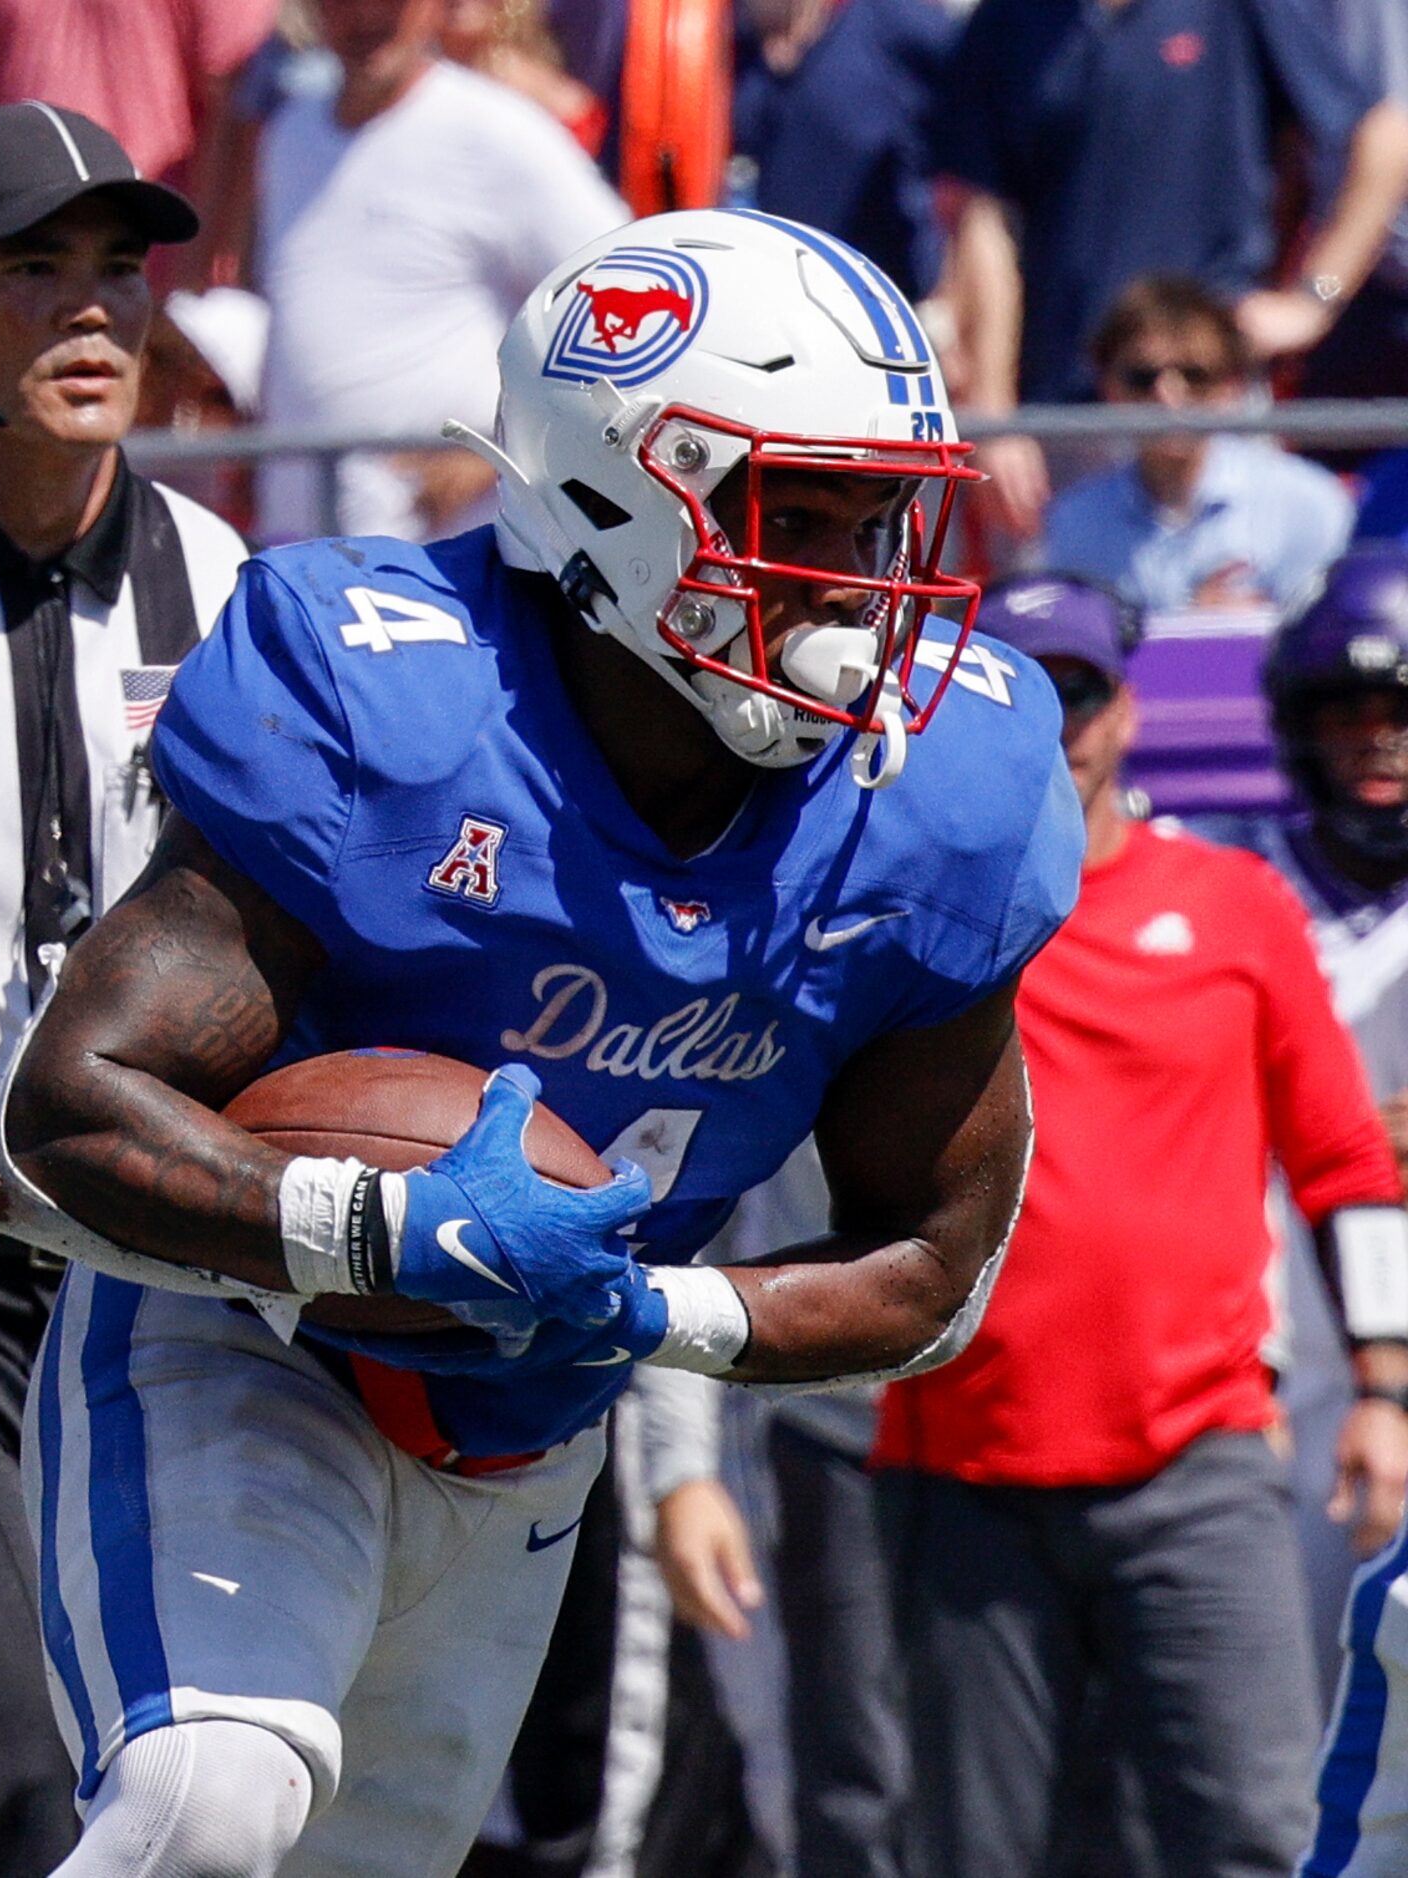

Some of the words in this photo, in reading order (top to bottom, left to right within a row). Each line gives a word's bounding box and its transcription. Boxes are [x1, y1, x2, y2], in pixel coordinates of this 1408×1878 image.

[338, 585, 469, 654] 4
[912, 638, 1019, 709] 4
[426, 815, 506, 906] A
[499, 963, 787, 1082] Dallas
[351, 1214, 364, 1239] WE
[352, 1180, 369, 1213] CAN
